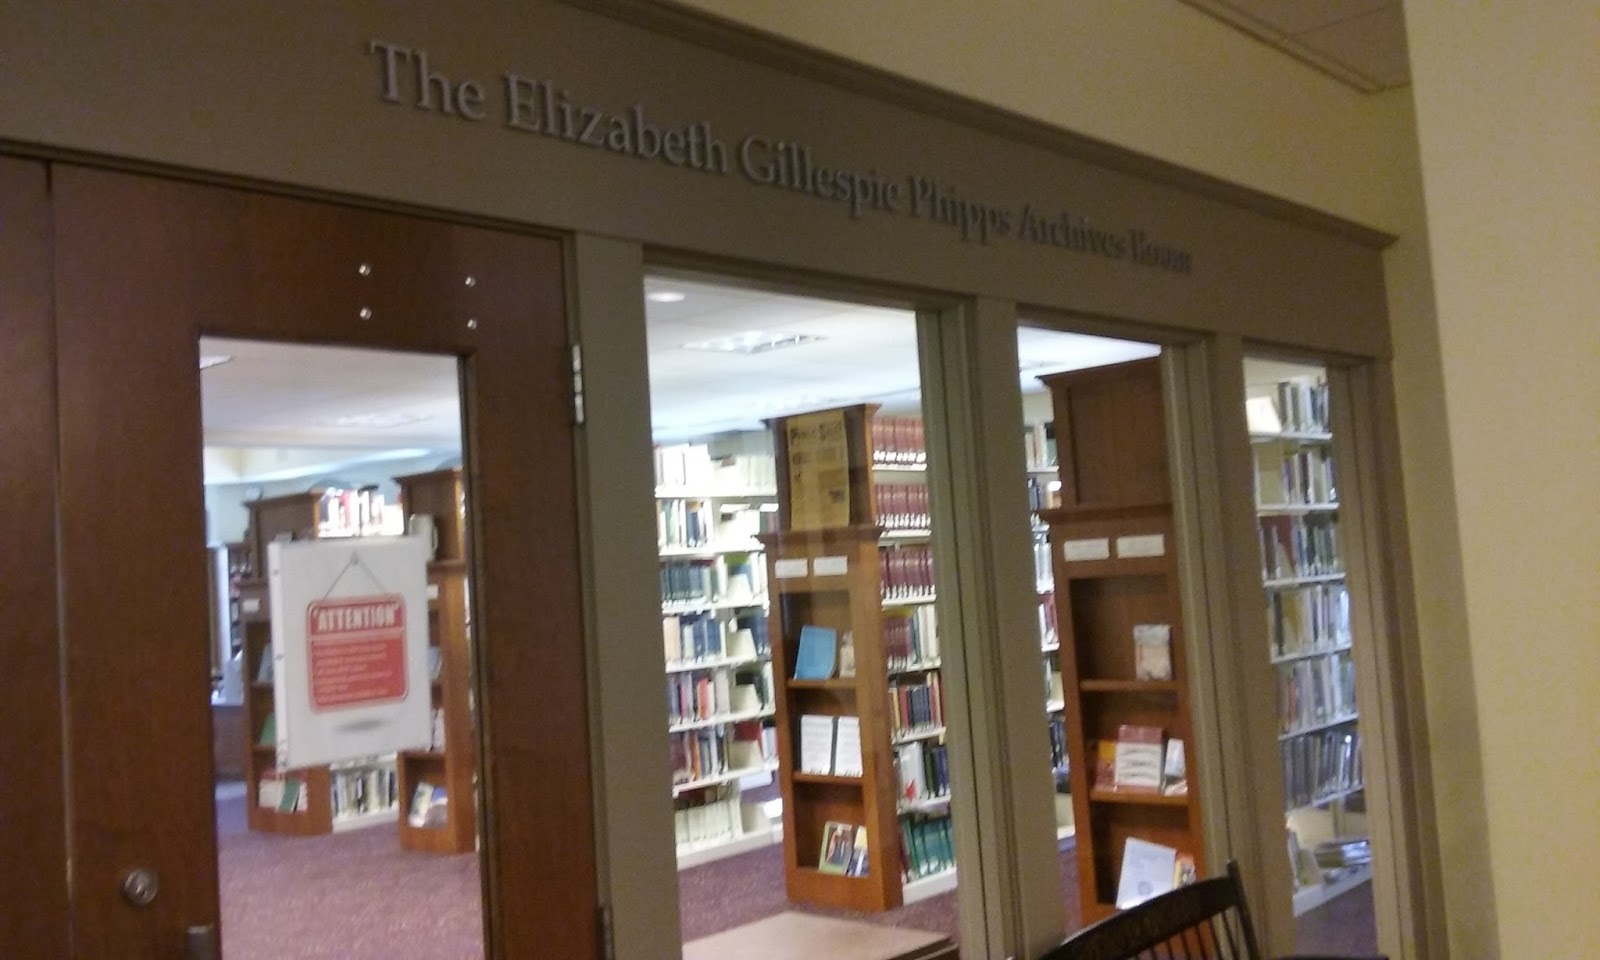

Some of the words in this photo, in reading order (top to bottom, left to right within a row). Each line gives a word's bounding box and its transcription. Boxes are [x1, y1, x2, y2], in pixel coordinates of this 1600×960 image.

[368, 40, 486, 121] The
[504, 72, 729, 174] Elizabeth
[739, 134, 902, 218] Gillespie
[909, 175, 1012, 246] Phipps
[317, 604, 396, 632] ATTENTION
